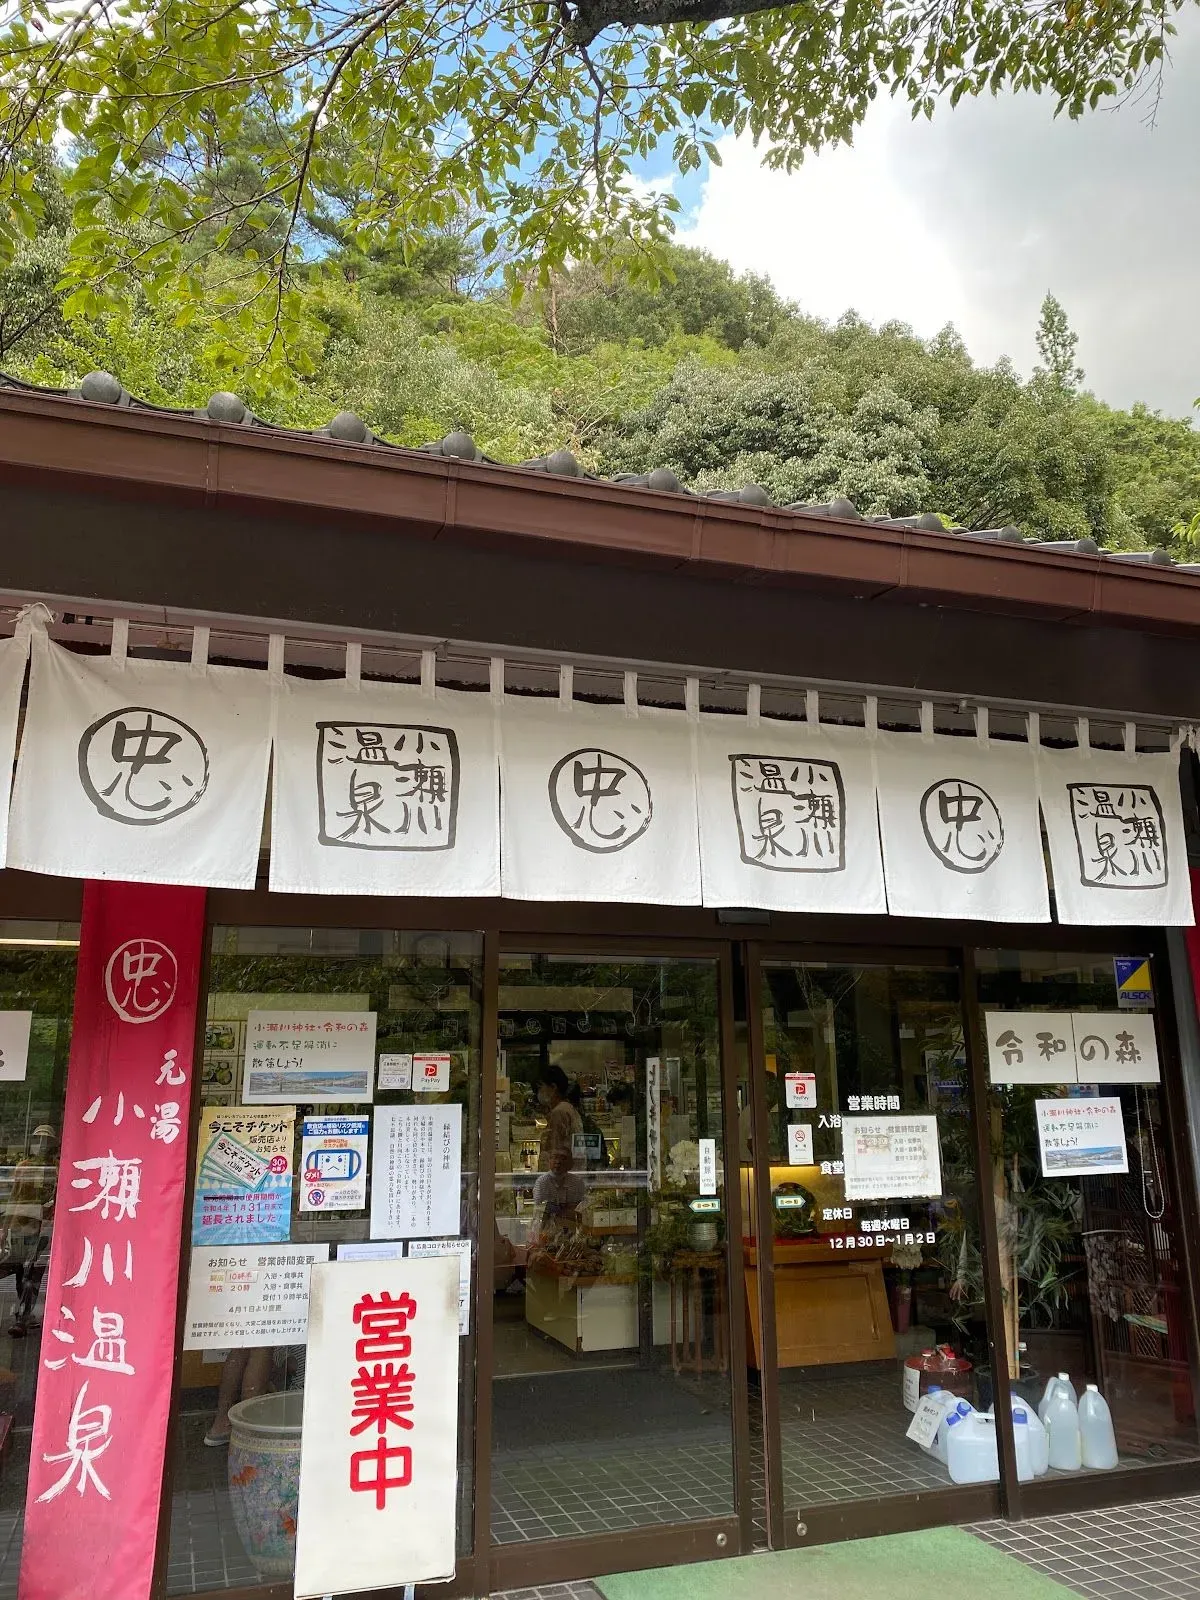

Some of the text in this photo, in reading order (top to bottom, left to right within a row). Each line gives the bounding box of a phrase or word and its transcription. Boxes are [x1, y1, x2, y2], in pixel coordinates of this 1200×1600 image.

[101, 714, 195, 811] 忠
[326, 727, 397, 841] 温泉
[394, 731, 448, 834] 小瀬川
[573, 754, 642, 839] 忠
[740, 758, 798, 861] 温泉
[790, 763, 836, 857] 小瀬川
[937, 784, 995, 856] 忠
[1076, 786, 1124, 884] 温泉
[1116, 787, 1163, 879] 小瀬川
[120, 941, 171, 1012] 忠
[1120, 992, 1152, 1000] ALSOK
[253, 1040, 338, 1051] 運動不足解消に
[995, 1029, 1142, 1066] 令和の森
[252, 1057, 304, 1070] 散策しよう!
[420, 1077, 442, 1085] PayPay
[148, 1048, 187, 1145] 元湯
[847, 1095, 901, 1111] 営業時間
[208, 1119, 288, 1134] 今こそチケット
[818, 1115, 842, 1129] 入浴
[256, 1145, 288, 1153] お知らせ
[820, 1160, 845, 1175] 食堂
[202, 1213, 283, 1226] 延長されました!
[822, 1208, 853, 1221] 定休日
[860, 1217, 910, 1233] 毎週水曜日
[208, 1257, 248, 1268] お知らせ
[257, 1255, 315, 1267] 営業時間変更
[34, 1090, 147, 1504] 小瀬川温泉
[349, 1291, 418, 1511] 営業中
